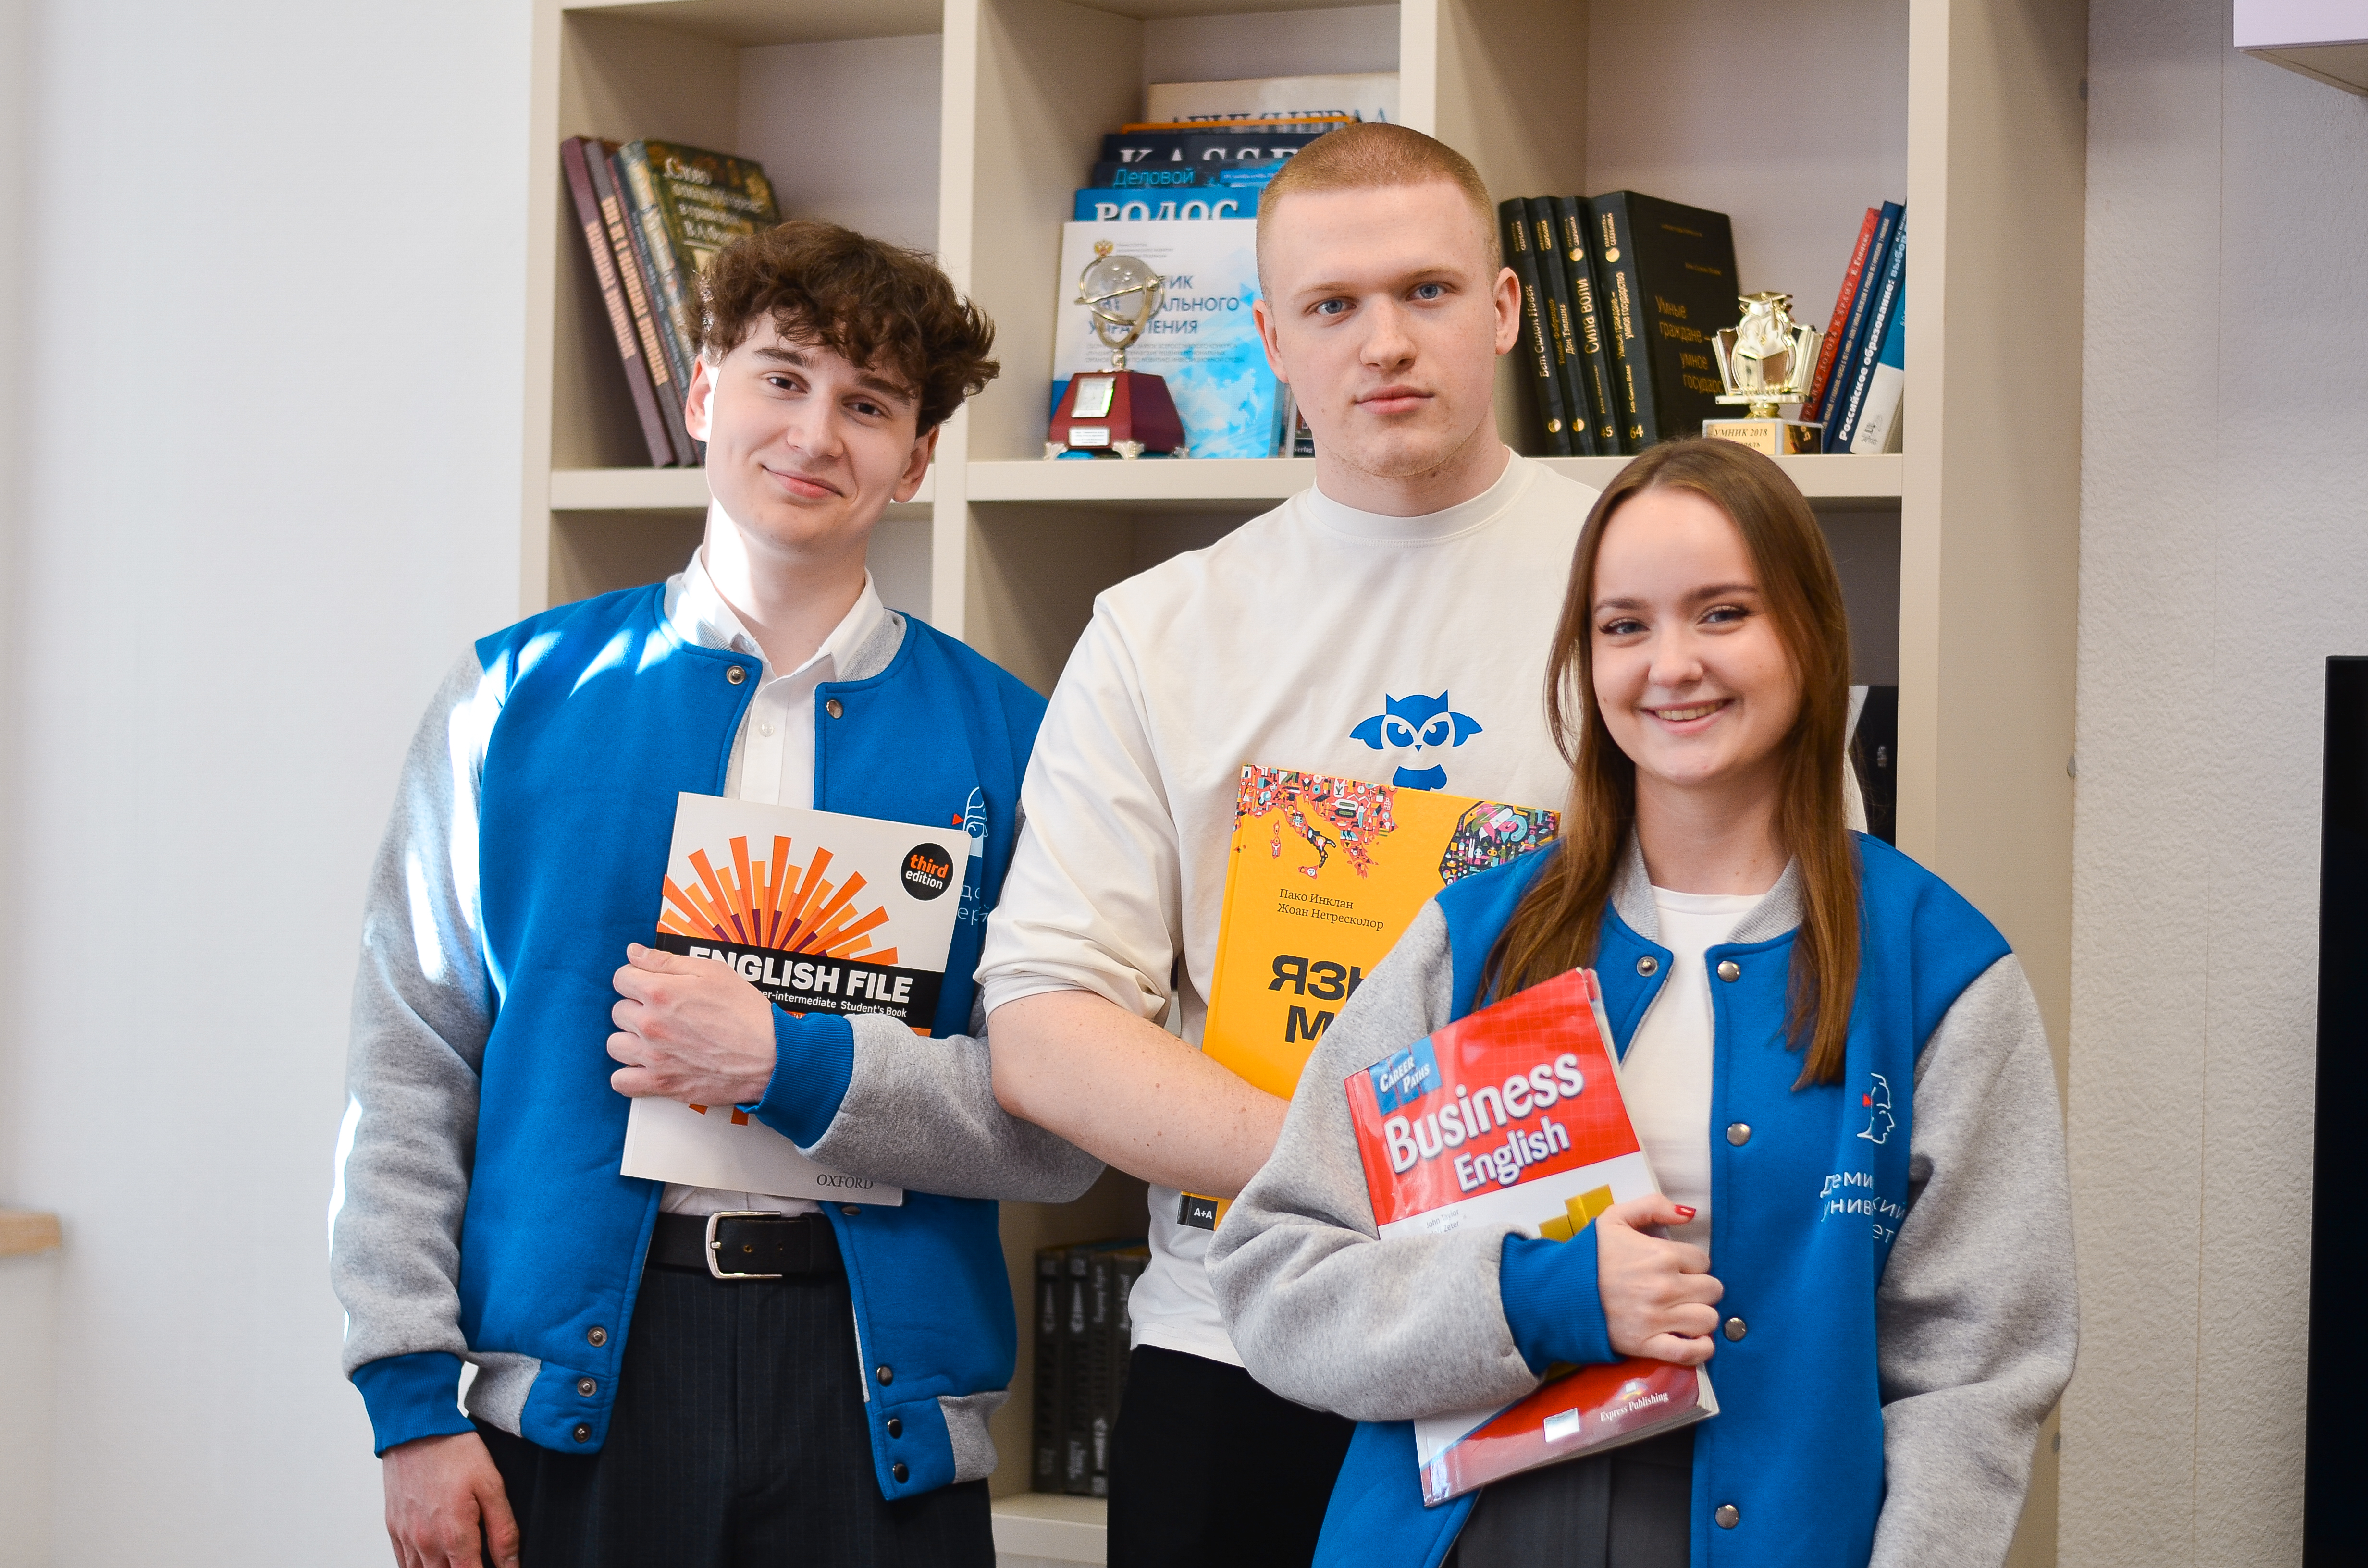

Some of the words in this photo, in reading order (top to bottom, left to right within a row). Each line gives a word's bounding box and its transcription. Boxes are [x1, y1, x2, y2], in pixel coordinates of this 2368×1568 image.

[1113, 168, 1195, 188] Деловой
[1577, 277, 1593, 314] воли
[1583, 316, 1600, 354] Сила
[1839, 367, 1868, 441] Российское
[1863, 279, 1895, 366] образование:
[1682, 373, 1724, 395] государс
[1714, 429, 1747, 437] УМНИК
[1750, 429, 1768, 437] 2018
[910, 854, 950, 878] third
[905, 870, 944, 890] edition
[1279, 888, 1307, 902] Пако
[1309, 893, 1354, 909] Инклан
[1277, 903, 1309, 917] Жоан
[1310, 908, 1384, 931] Негресколор
[846, 969, 913, 1004] FILE
[759, 990, 837, 1008] er-intermediate
[840, 1001, 884, 1015] Student's
[886, 1006, 907, 1018] Book
[1383, 1052, 1586, 1175] Business
[1453, 1115, 1571, 1193] English
[816, 1174, 874, 1190] OXFORD
[1426, 1217, 1441, 1229] John
[1441, 1209, 1460, 1221] Taylor
[1444, 1221, 1460, 1233] Zeter
[1600, 1404, 1628, 1422] Express
[1628, 1390, 1669, 1412] Publishing
